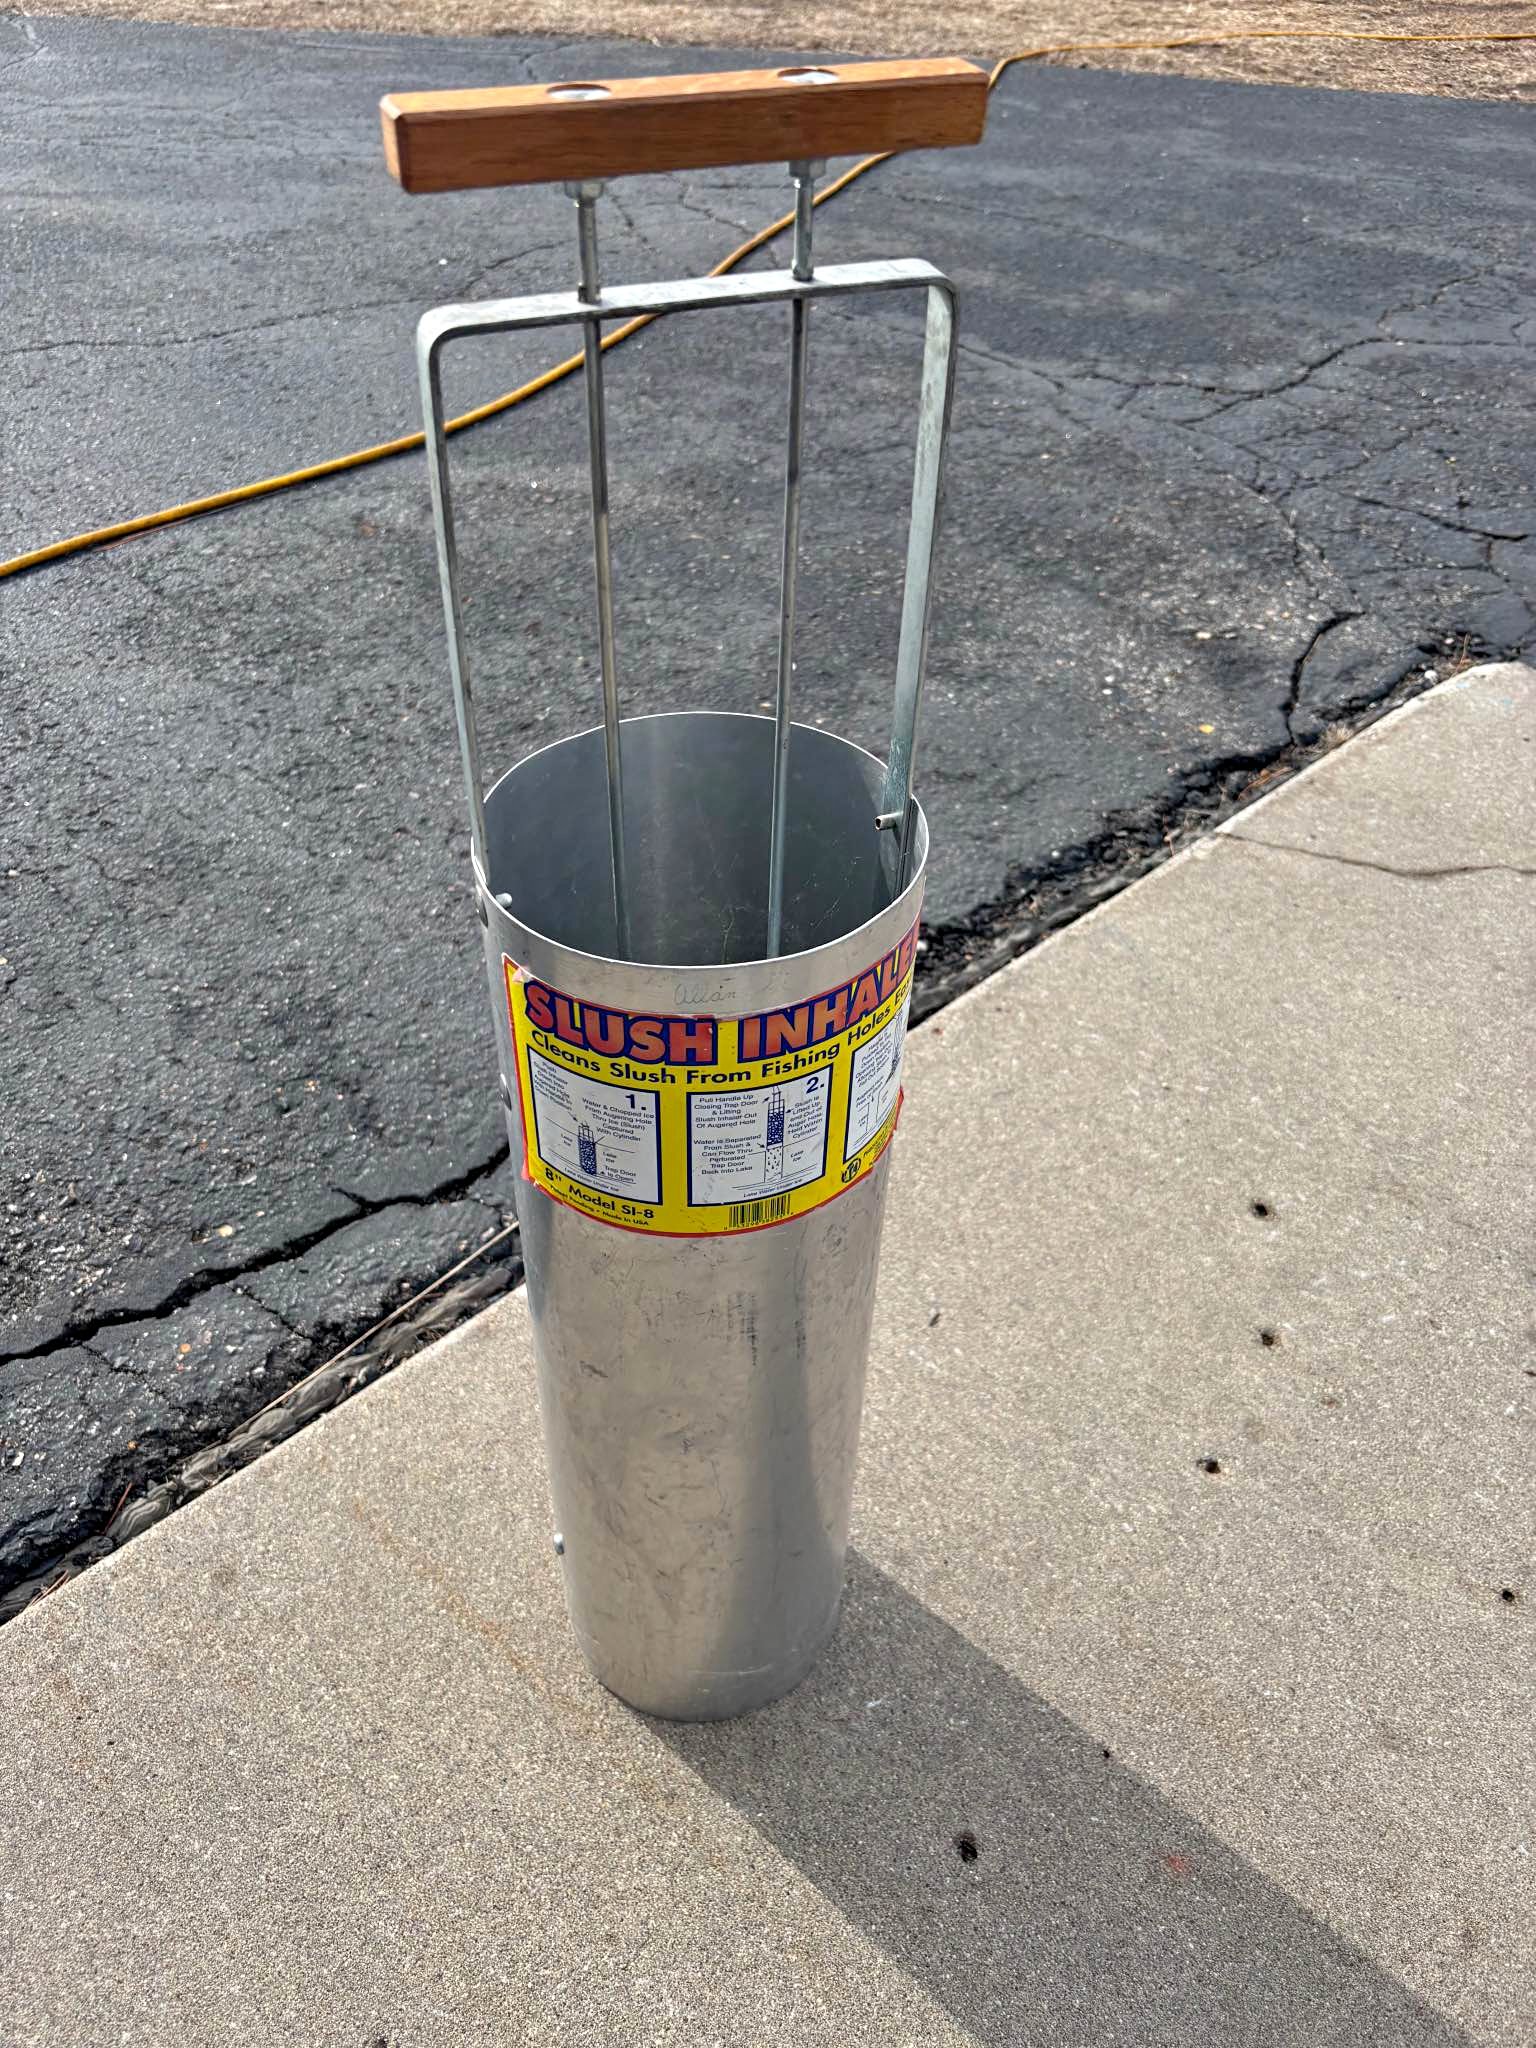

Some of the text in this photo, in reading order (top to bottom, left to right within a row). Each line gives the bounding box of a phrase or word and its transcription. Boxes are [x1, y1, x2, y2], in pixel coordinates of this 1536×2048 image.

[525, 980, 717, 1066] SLUSH
[532, 1031, 600, 1072] Cleans
[610, 1062, 675, 1084] Slush
[687, 1067, 750, 1084] From
[762, 1042, 840, 1077] Fishing
[848, 1006, 891, 1046] Holes
[806, 1076, 825, 1094] 2.
[625, 1094, 646, 1111] 1.
[609, 1106, 642, 1118] Chopped
[568, 1184, 616, 1211] Model
[621, 1204, 654, 1219] SI-8
[632, 1218, 649, 1226] USA
